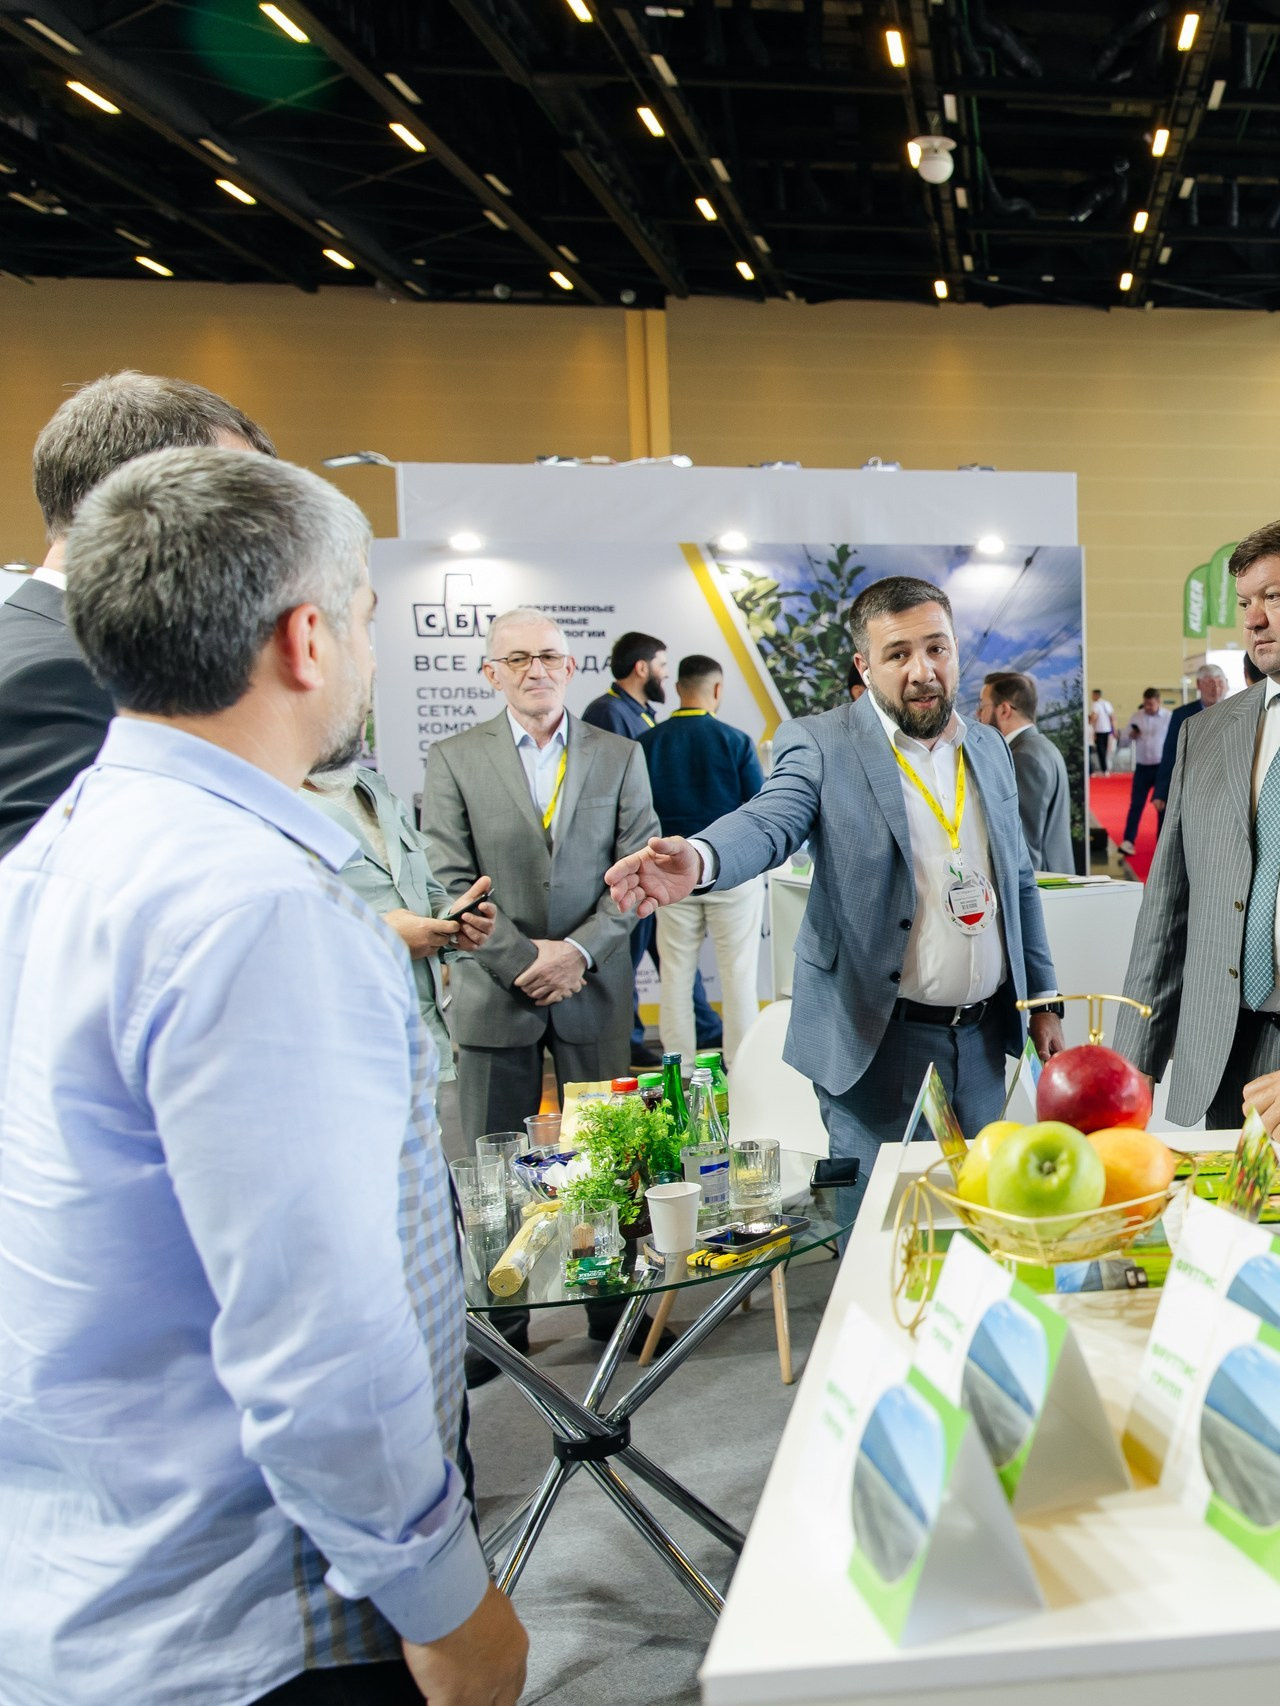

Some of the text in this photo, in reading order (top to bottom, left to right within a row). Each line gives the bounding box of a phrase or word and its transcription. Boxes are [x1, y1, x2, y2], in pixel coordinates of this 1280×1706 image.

[415, 655, 467, 671] ВСЕ
[416, 687, 496, 699] СТОЛБЫ
[417, 704, 477, 717] СЕТКА
